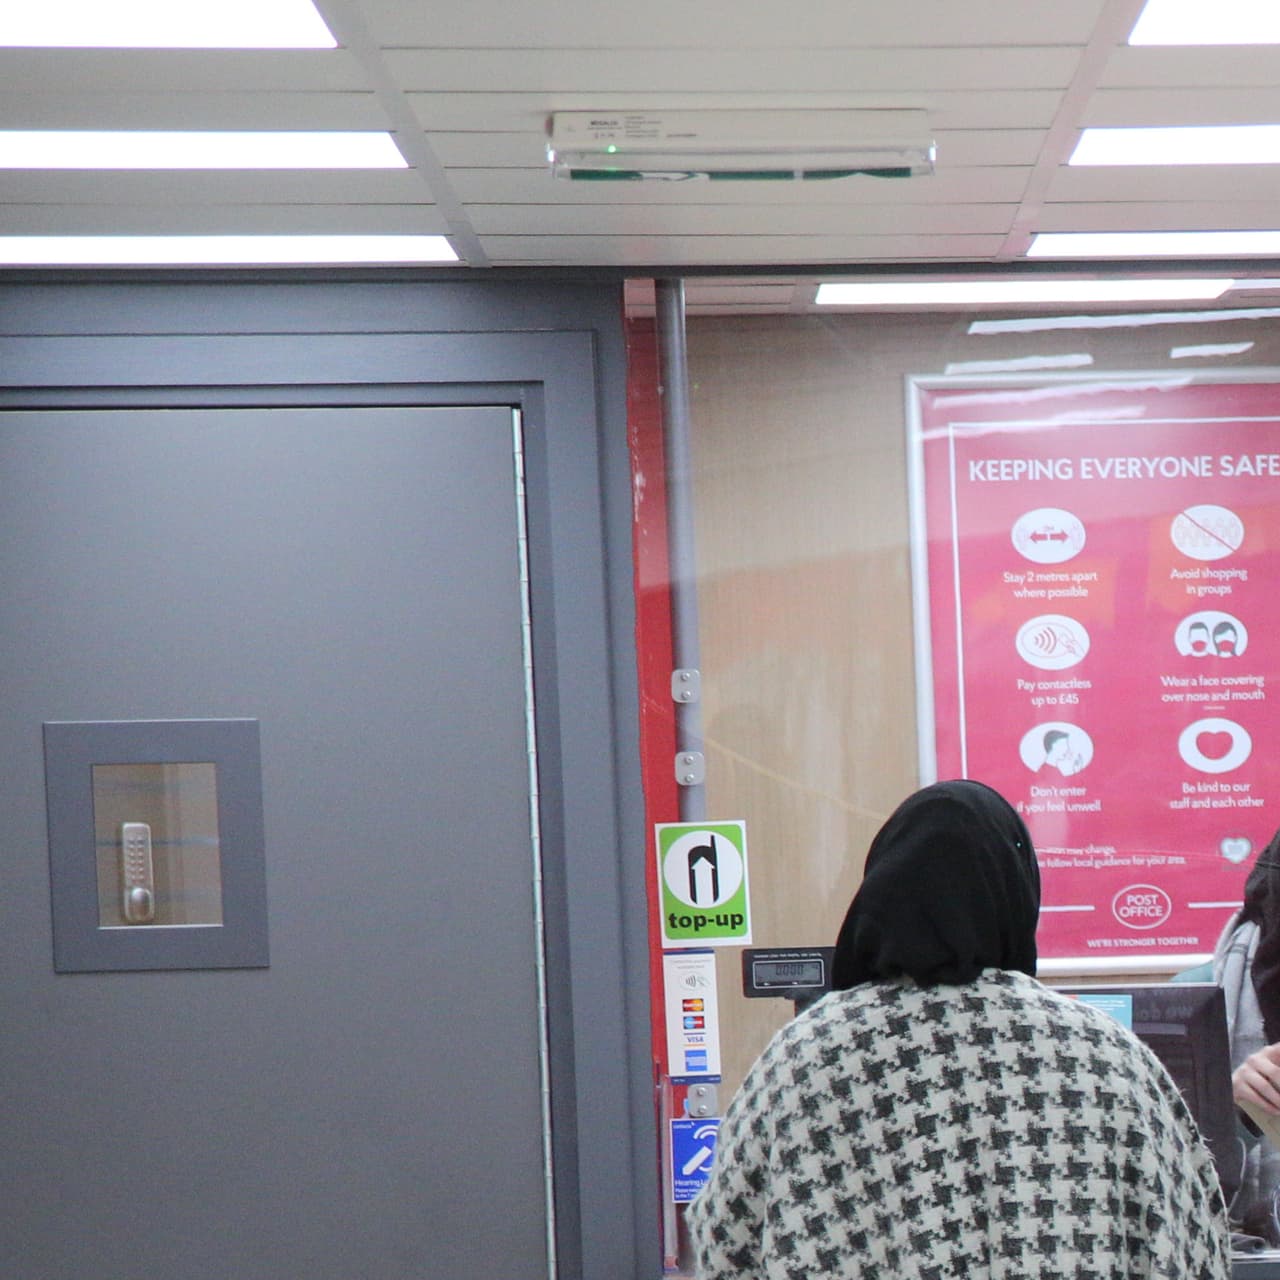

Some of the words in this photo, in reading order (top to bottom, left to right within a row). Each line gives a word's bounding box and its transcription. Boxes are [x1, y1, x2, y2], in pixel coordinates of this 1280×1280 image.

[969, 458, 1073, 481] KEEPING
[1081, 455, 1213, 480] EVERYONE
[1220, 453, 1280, 477] SAFE
[1003, 571, 1025, 585] Stay
[1026, 571, 1034, 582] 2
[1170, 568, 1200, 579] Avoid
[1201, 567, 1248, 581] shopping
[1013, 587, 1046, 598] where
[1047, 585, 1089, 600] possible
[1197, 586, 1232, 597] groups
[1017, 679, 1035, 693] Pay
[1038, 677, 1092, 689] contactless
[1160, 676, 1189, 687] Wear
[1199, 674, 1219, 685] face
[1221, 675, 1265, 688] covering
[1031, 697, 1045, 708] up
[1046, 695, 1057, 704] to
[1161, 694, 1184, 702] over
[1186, 693, 1210, 701] nose
[1211, 689, 1230, 701] and
[1231, 689, 1265, 700] mouth
[1031, 786, 1057, 797] Don't
[1059, 787, 1086, 796] enter
[1182, 782, 1196, 793] Be
[1197, 781, 1218, 792] kind
[1220, 783, 1231, 792] to
[1232, 783, 1251, 792] our
[1047, 801, 1066, 812] feel
[1067, 799, 1101, 811] unwell
[1169, 797, 1190, 808] staff
[1191, 797, 1210, 808] and
[1211, 796, 1236, 807] each
[1238, 796, 1265, 807] other
[1132, 855, 1145, 865] for
[1126, 894, 1158, 905] POST
[1119, 905, 1163, 918] OFFICE
[668, 911, 744, 930] top-up
[1114, 938, 1156, 946] STRONGER
[1157, 937, 1198, 945] TOGETHER
